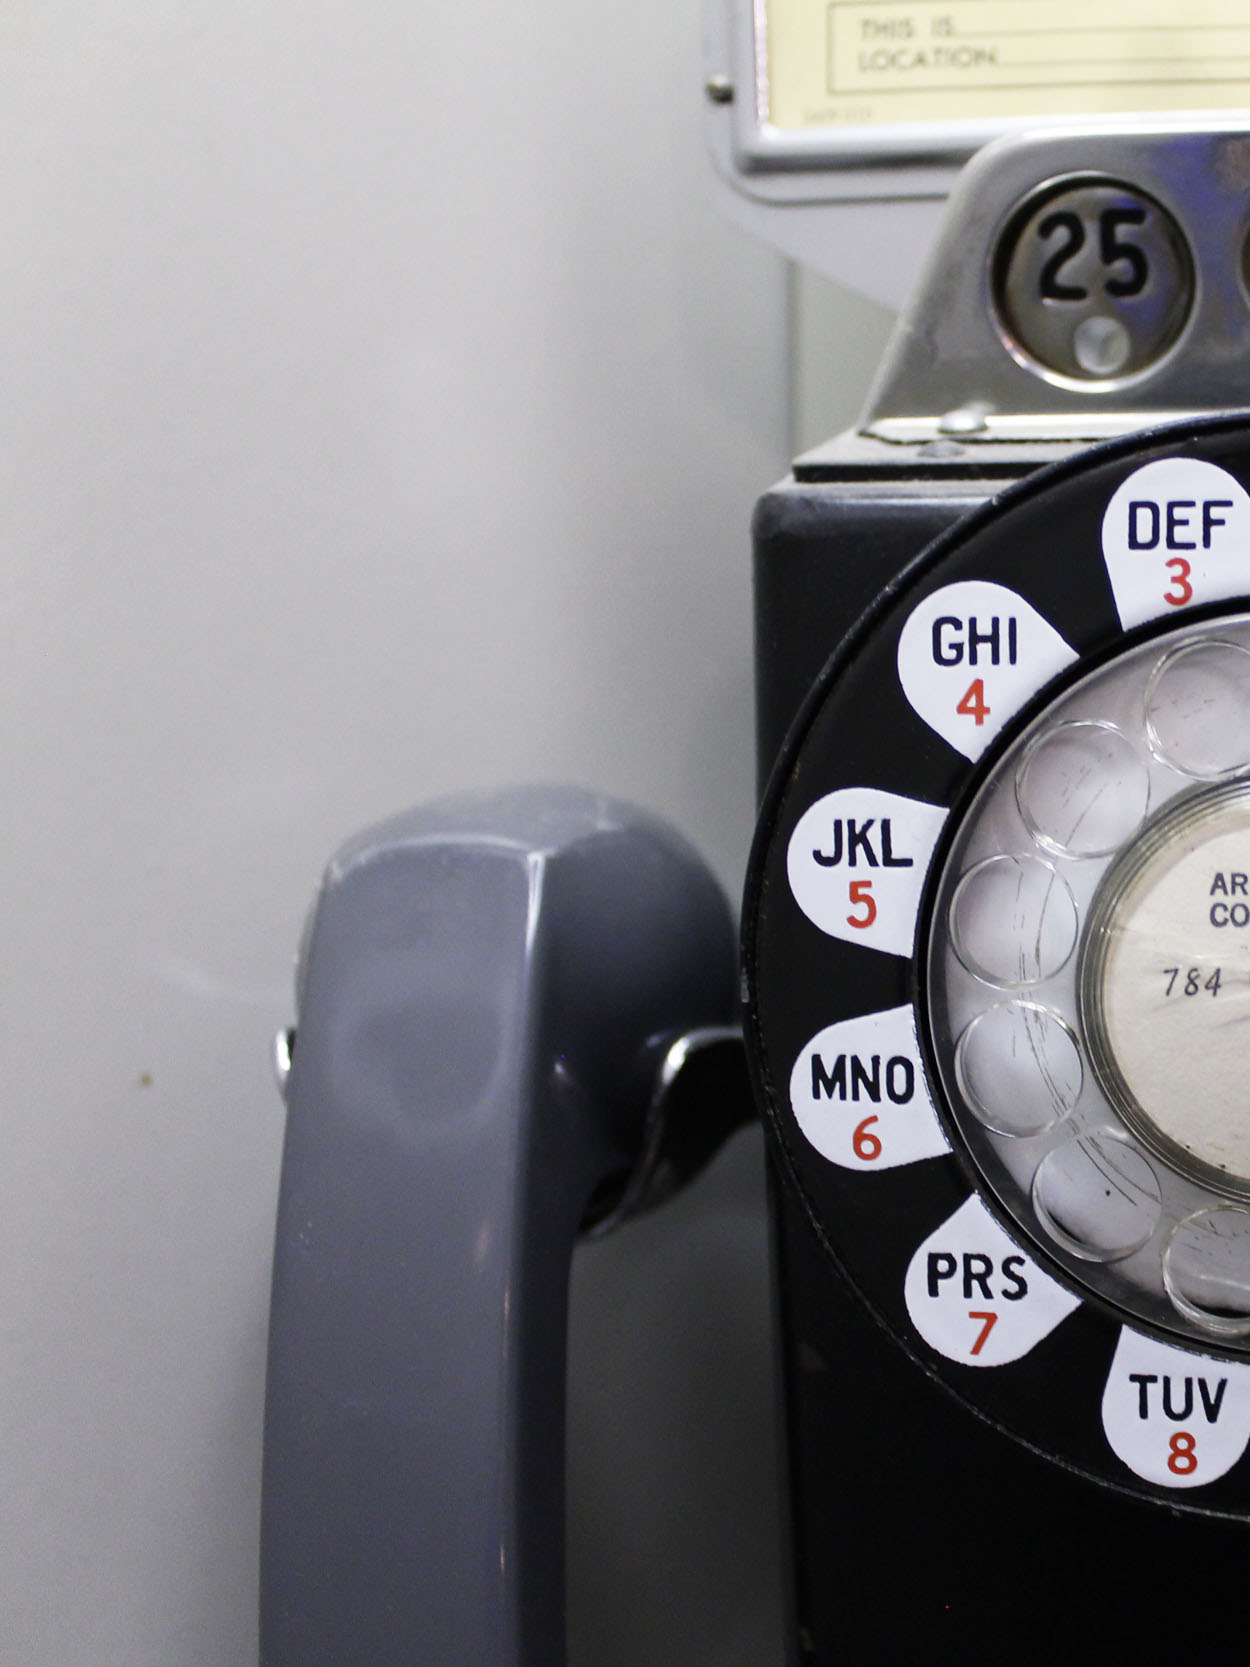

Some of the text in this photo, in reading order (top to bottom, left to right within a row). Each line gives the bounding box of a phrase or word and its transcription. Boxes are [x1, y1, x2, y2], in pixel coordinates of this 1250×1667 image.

[860, 17, 915, 40] THIS
[931, 16, 954, 38] IS
[859, 46, 998, 73] LOCATION
[1037, 209, 1147, 301] 25
[1128, 500, 1233, 550] DEF
[1164, 557, 1193, 606] 3
[932, 616, 1018, 666] GHI
[957, 679, 991, 726] 4
[813, 819, 914, 867] JKL
[847, 880, 877, 929] 5
[1163, 967, 1222, 997] 784
[811, 1054, 915, 1104] MNO
[853, 1115, 882, 1161] 6
[927, 1252, 1029, 1301] PRS
[969, 1311, 998, 1356] 7
[1129, 1374, 1228, 1424] TUV
[1167, 1431, 1198, 1475] 8
